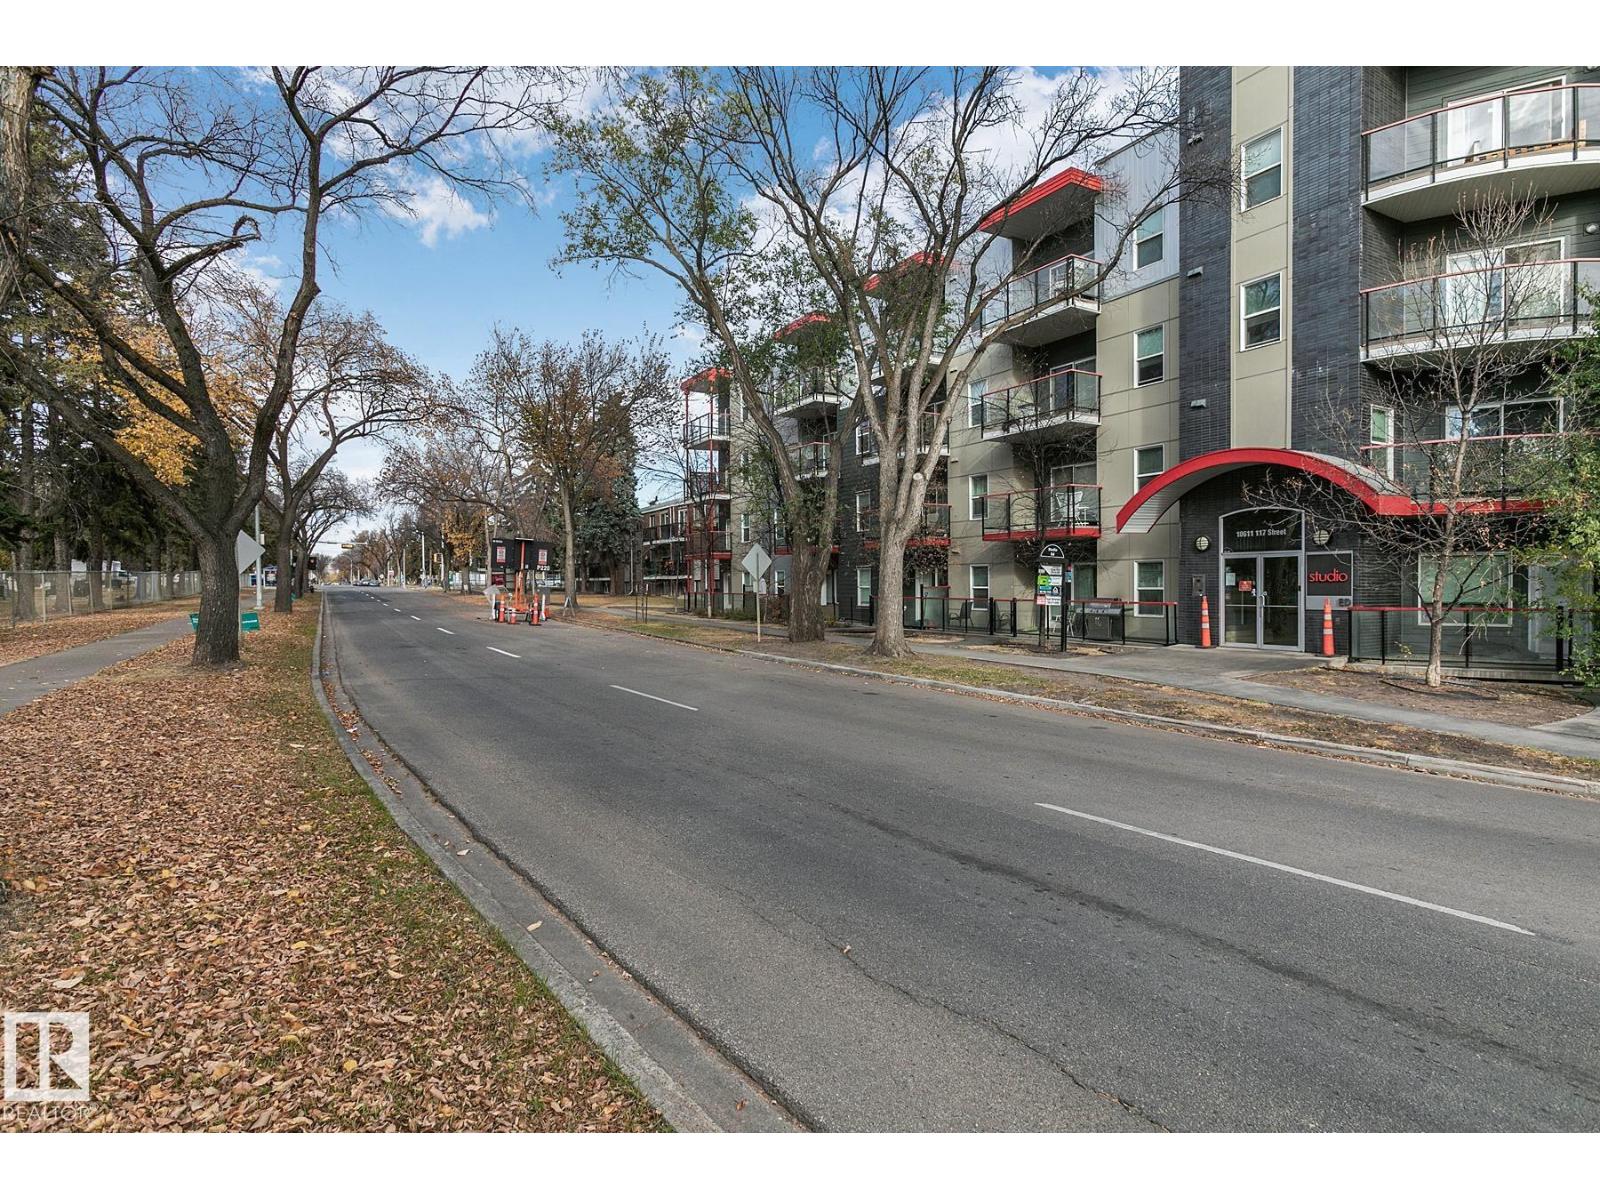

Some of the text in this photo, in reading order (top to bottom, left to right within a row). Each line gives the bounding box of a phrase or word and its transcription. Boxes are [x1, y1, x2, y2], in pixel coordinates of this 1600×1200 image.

[1255, 529, 1266, 537] 117
[1267, 528, 1287, 536] Street
[1309, 568, 1348, 582] studio
